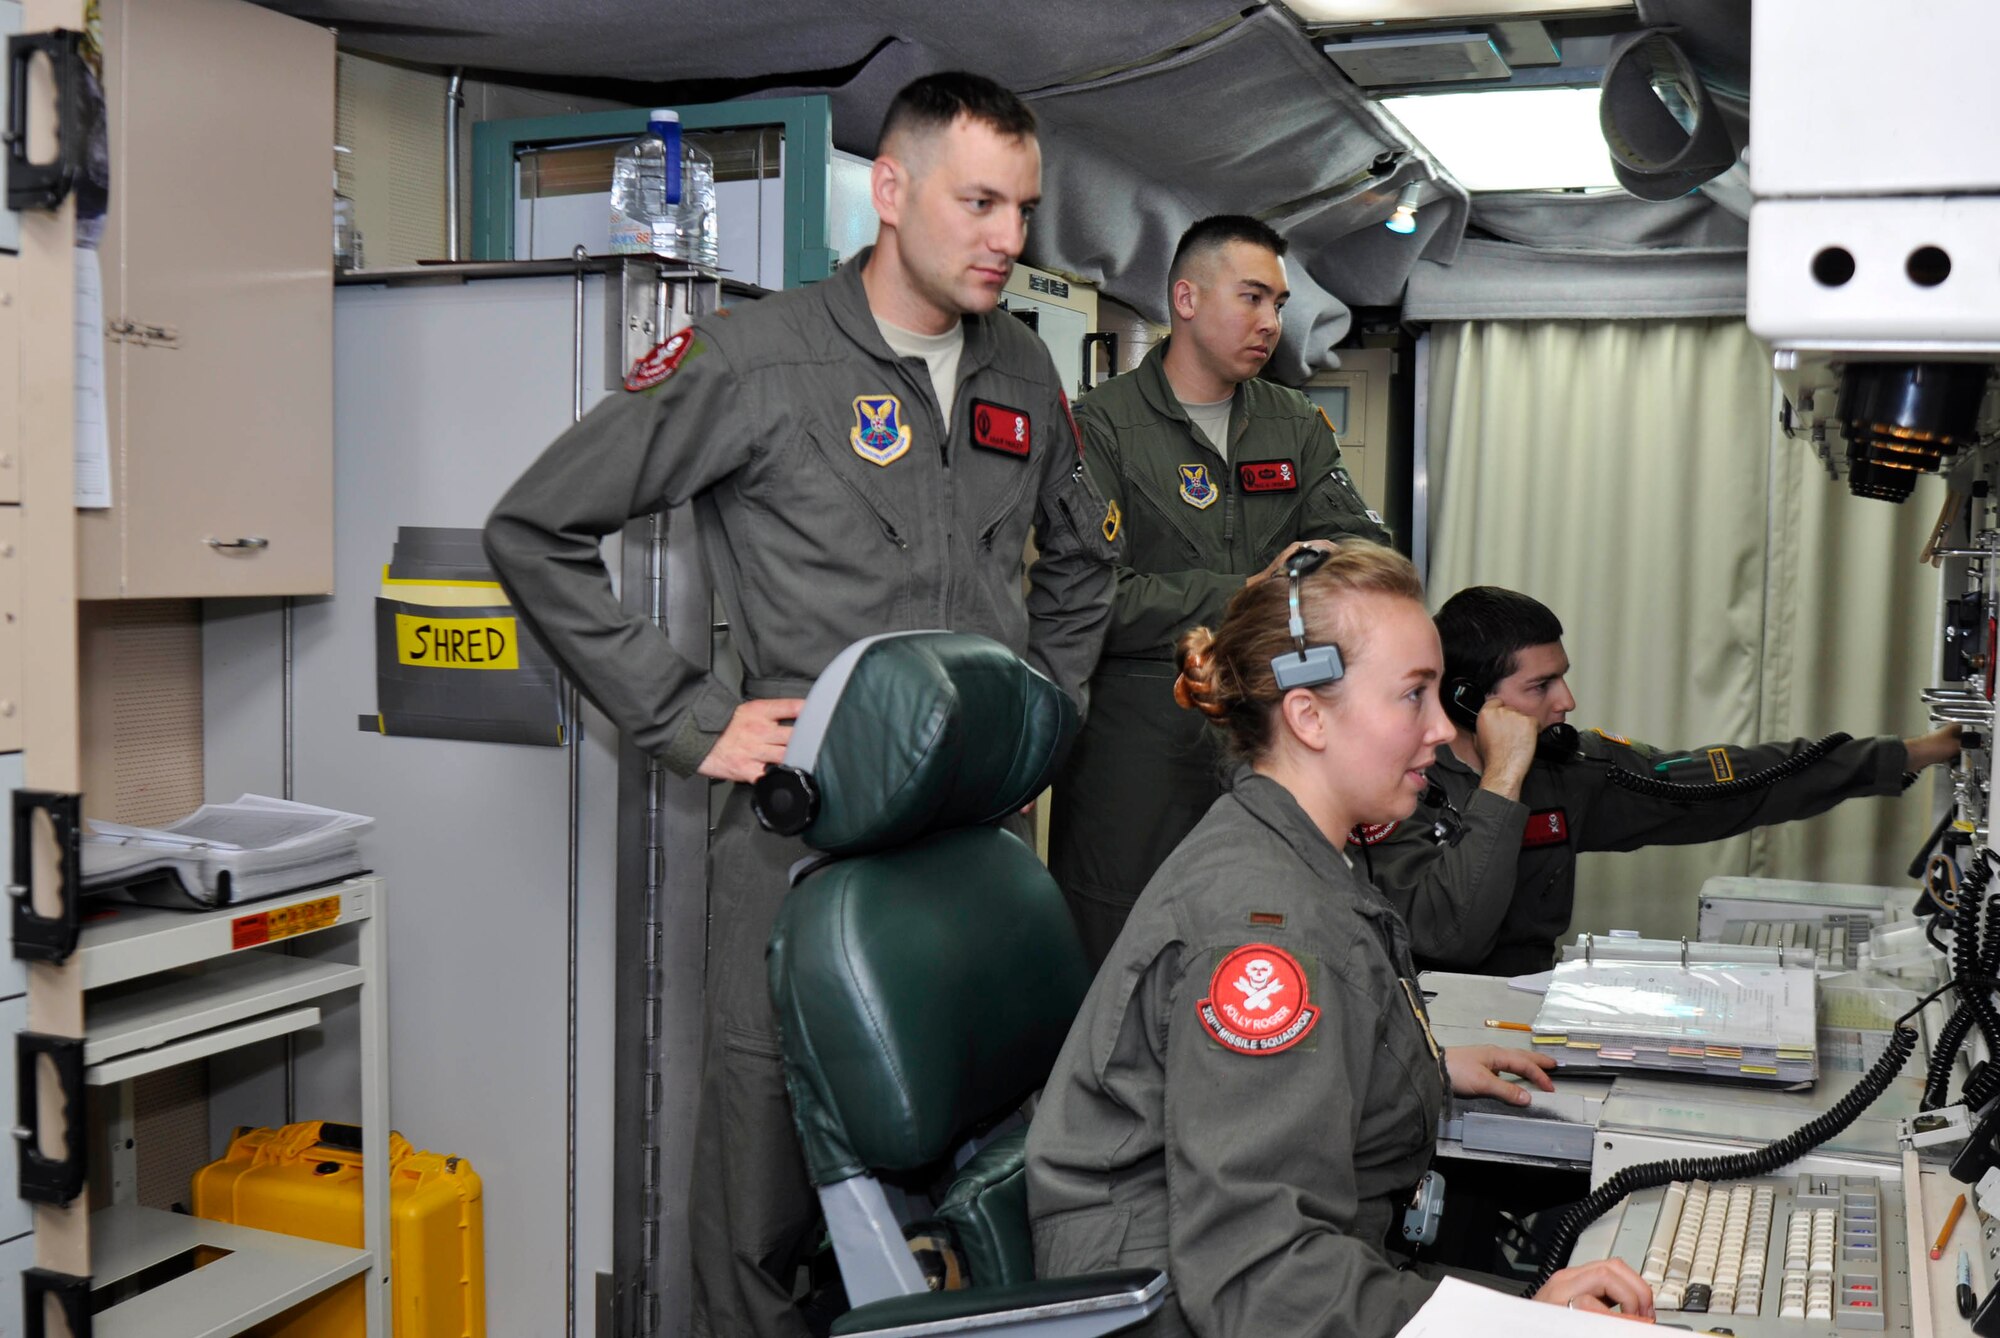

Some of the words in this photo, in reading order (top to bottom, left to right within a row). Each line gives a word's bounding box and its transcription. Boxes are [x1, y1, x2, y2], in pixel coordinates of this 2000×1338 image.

[410, 624, 505, 662] SHRED
[1217, 1028, 1258, 1049] MISSILE
[1260, 1010, 1313, 1049] SQUADRON
[1223, 1004, 1251, 1027] JOLLY
[1252, 1006, 1290, 1029] ROGER
